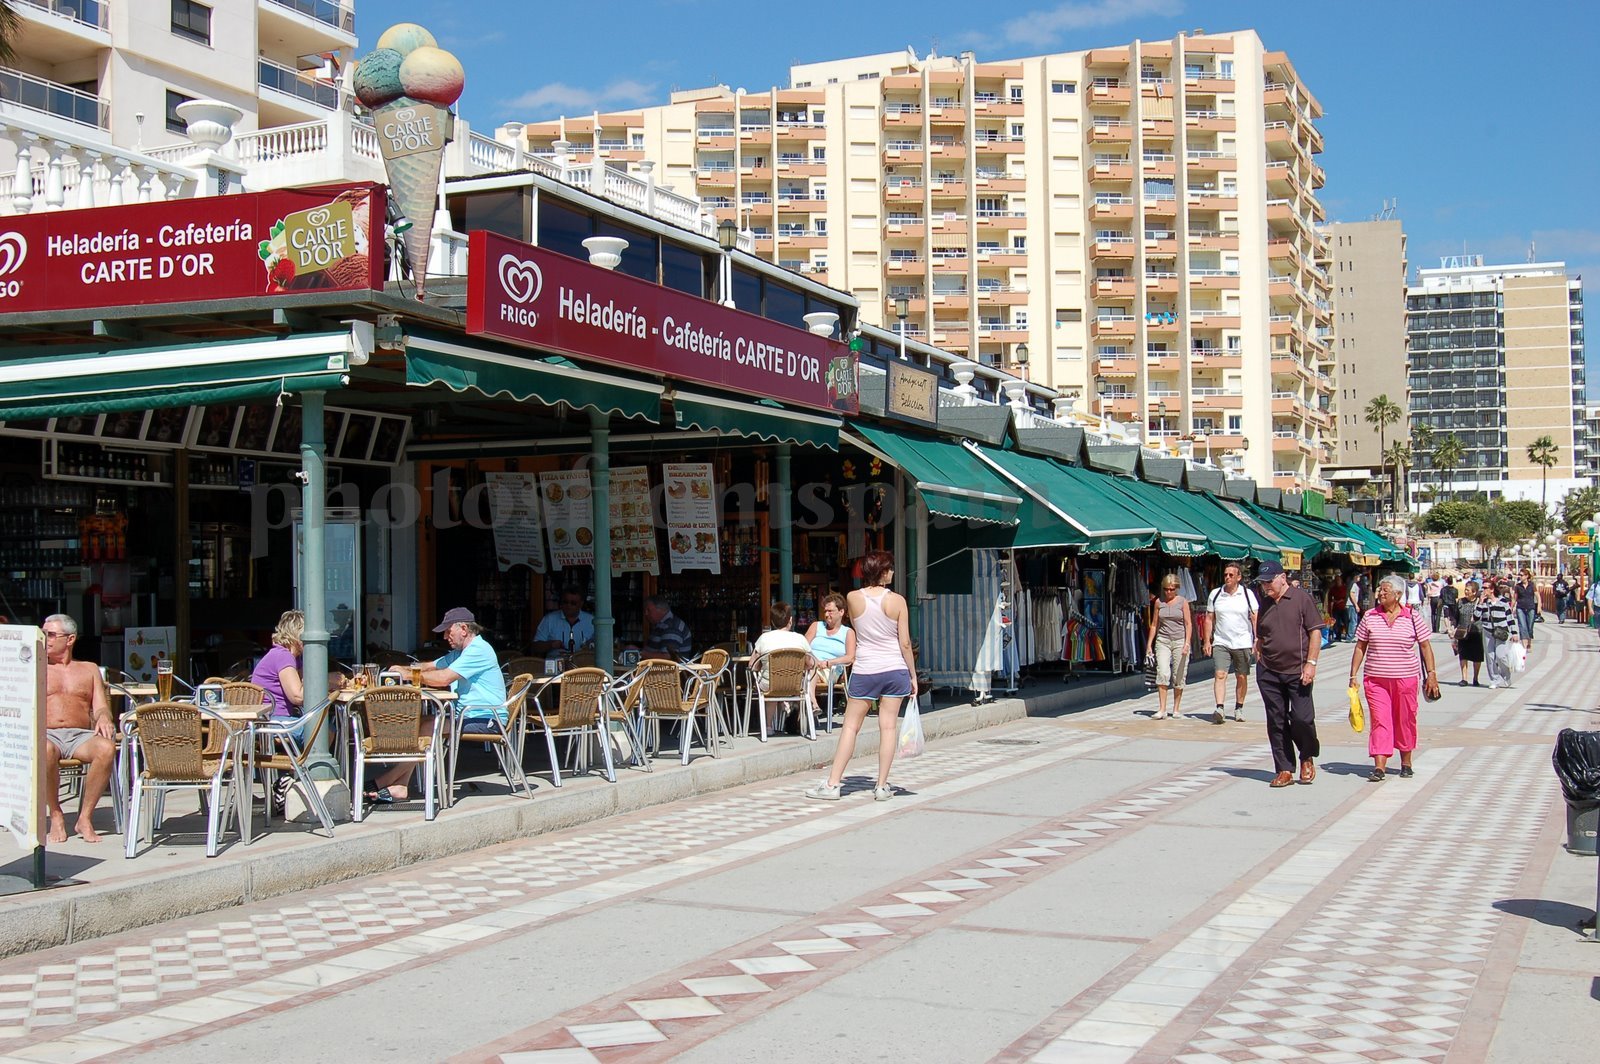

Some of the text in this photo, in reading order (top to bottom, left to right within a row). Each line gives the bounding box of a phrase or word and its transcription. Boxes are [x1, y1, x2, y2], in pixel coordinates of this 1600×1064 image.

[384, 116, 433, 139] CARTE
[392, 132, 433, 152] D'OR
[47, 228, 140, 257] Heladería
[158, 218, 253, 248] Cafetería
[291, 218, 348, 250] CARTE
[299, 241, 344, 267] D'OR
[81, 257, 152, 284] CARTE
[500, 303, 537, 328] FRIGO
[559, 286, 647, 339] Heladería
[663, 315, 731, 361] Cafetería
[735, 336, 783, 374] CARTE
[835, 368, 853, 382] CARTE
